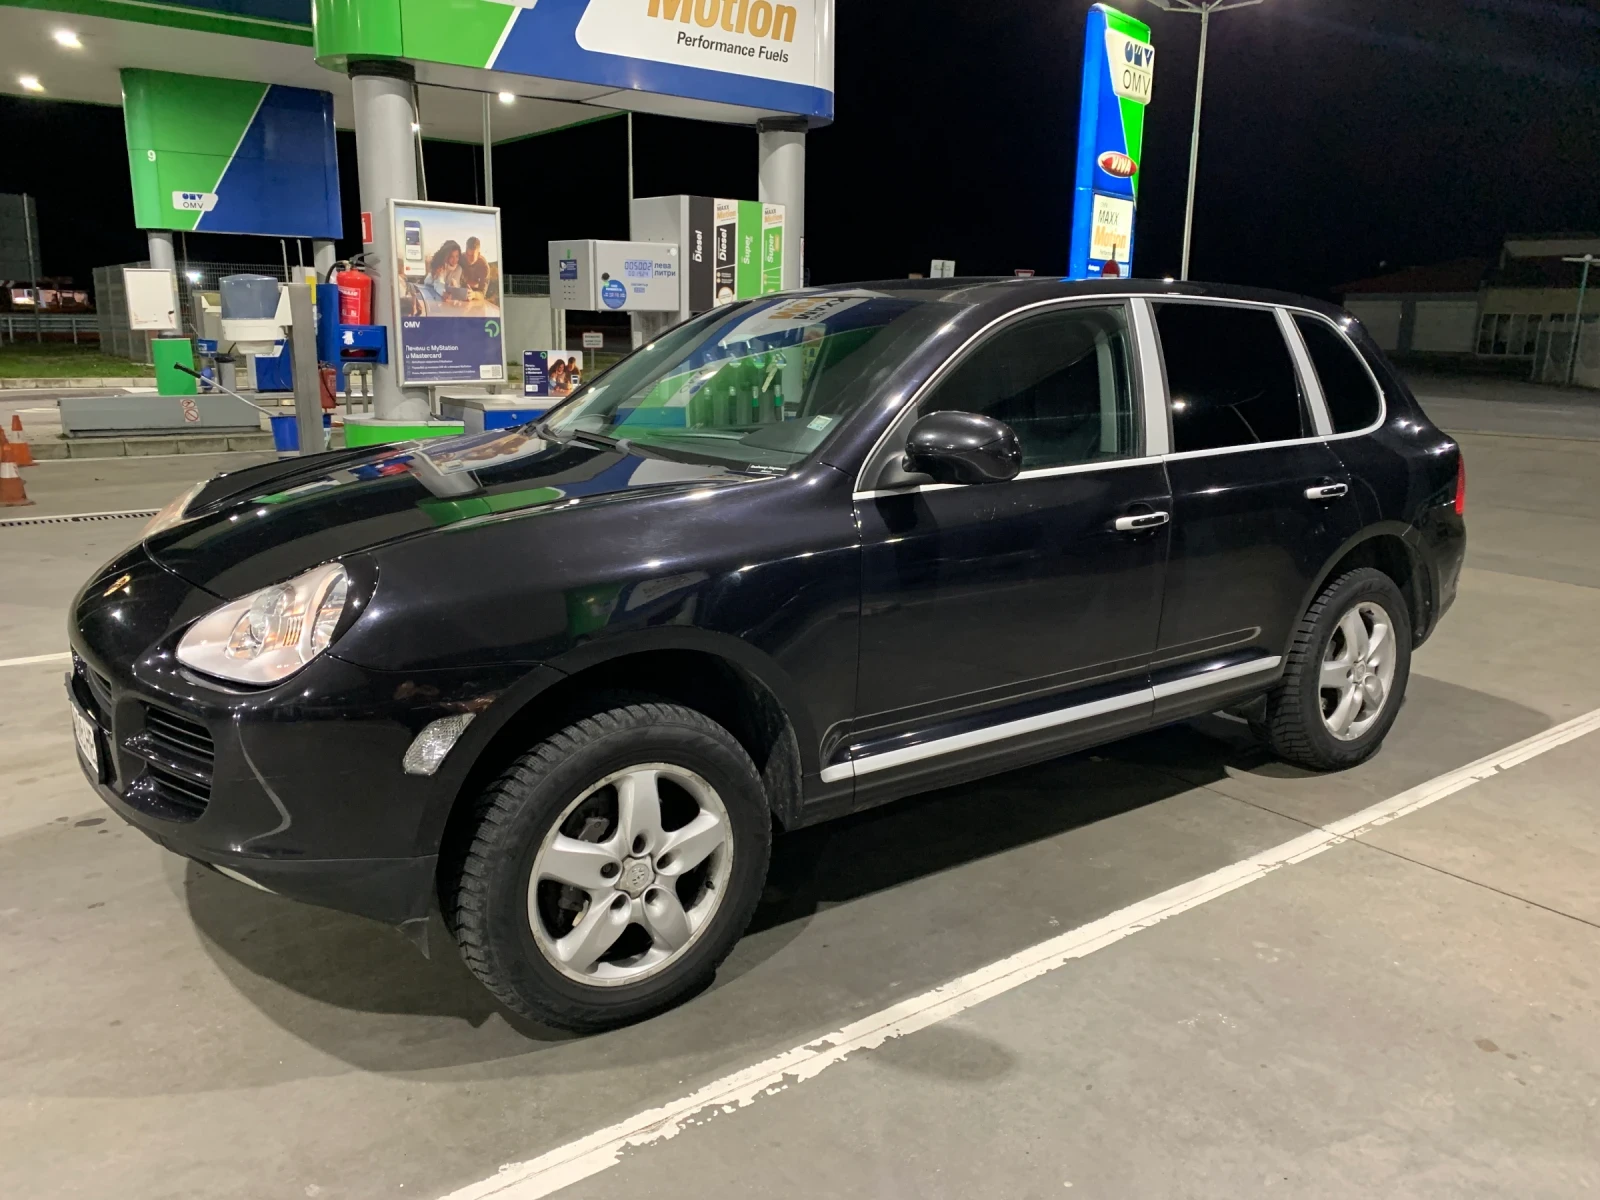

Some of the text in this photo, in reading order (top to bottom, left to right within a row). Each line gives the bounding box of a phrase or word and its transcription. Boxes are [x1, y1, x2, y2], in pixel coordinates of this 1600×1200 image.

[676, 31, 790, 63] Performance Fuels
[1122, 68, 1151, 96] OMV
[147, 149, 157, 162] 9
[1111, 155, 1132, 174] VIVA
[182, 201, 204, 209] OMV
[1098, 209, 1119, 225] MAXX
[694, 230, 702, 263] Diesel
[719, 228, 727, 261] Diesel
[1094, 225, 1126, 249] Motion
[743, 235, 752, 264] Super
[767, 233, 775, 263] Super
[654, 270, 676, 278] литри
[403, 321, 421, 329] OMV
[431, 344, 459, 352] MyStation
